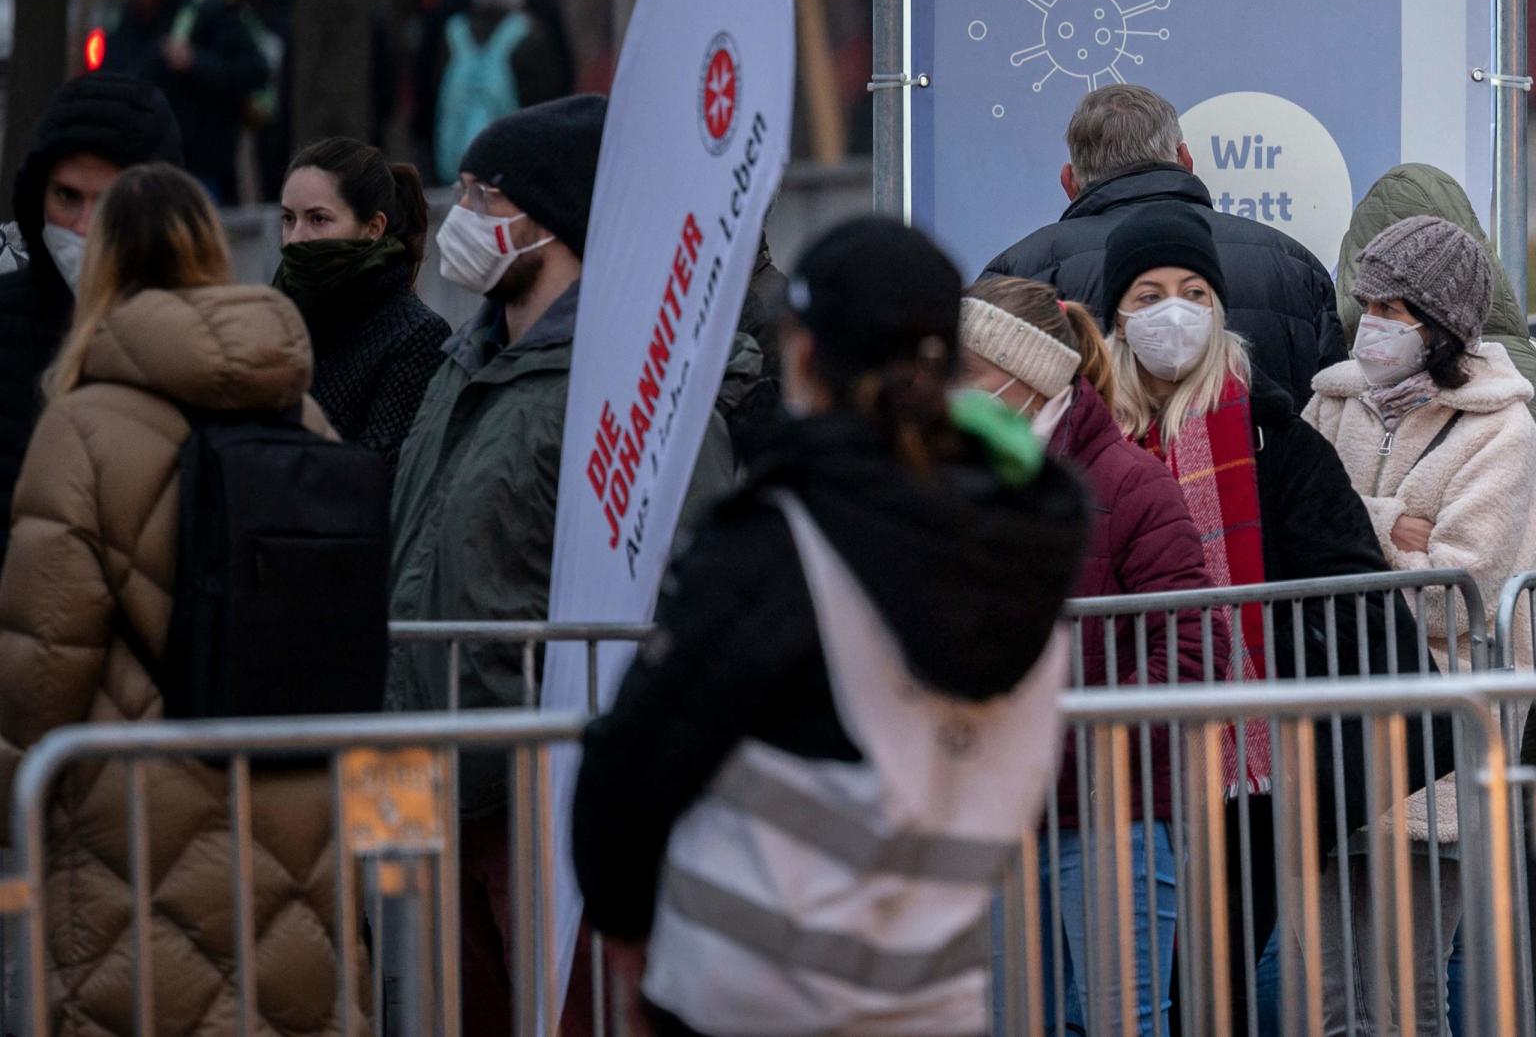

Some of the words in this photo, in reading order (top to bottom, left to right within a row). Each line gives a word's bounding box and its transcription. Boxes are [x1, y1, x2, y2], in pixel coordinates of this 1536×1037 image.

[719, 112, 767, 244] Leben
[1210, 133, 1282, 170] Wir
[1211, 191, 1293, 222] tatt
[602, 212, 704, 550] JOHANNITER
[586, 400, 622, 500] DIE
